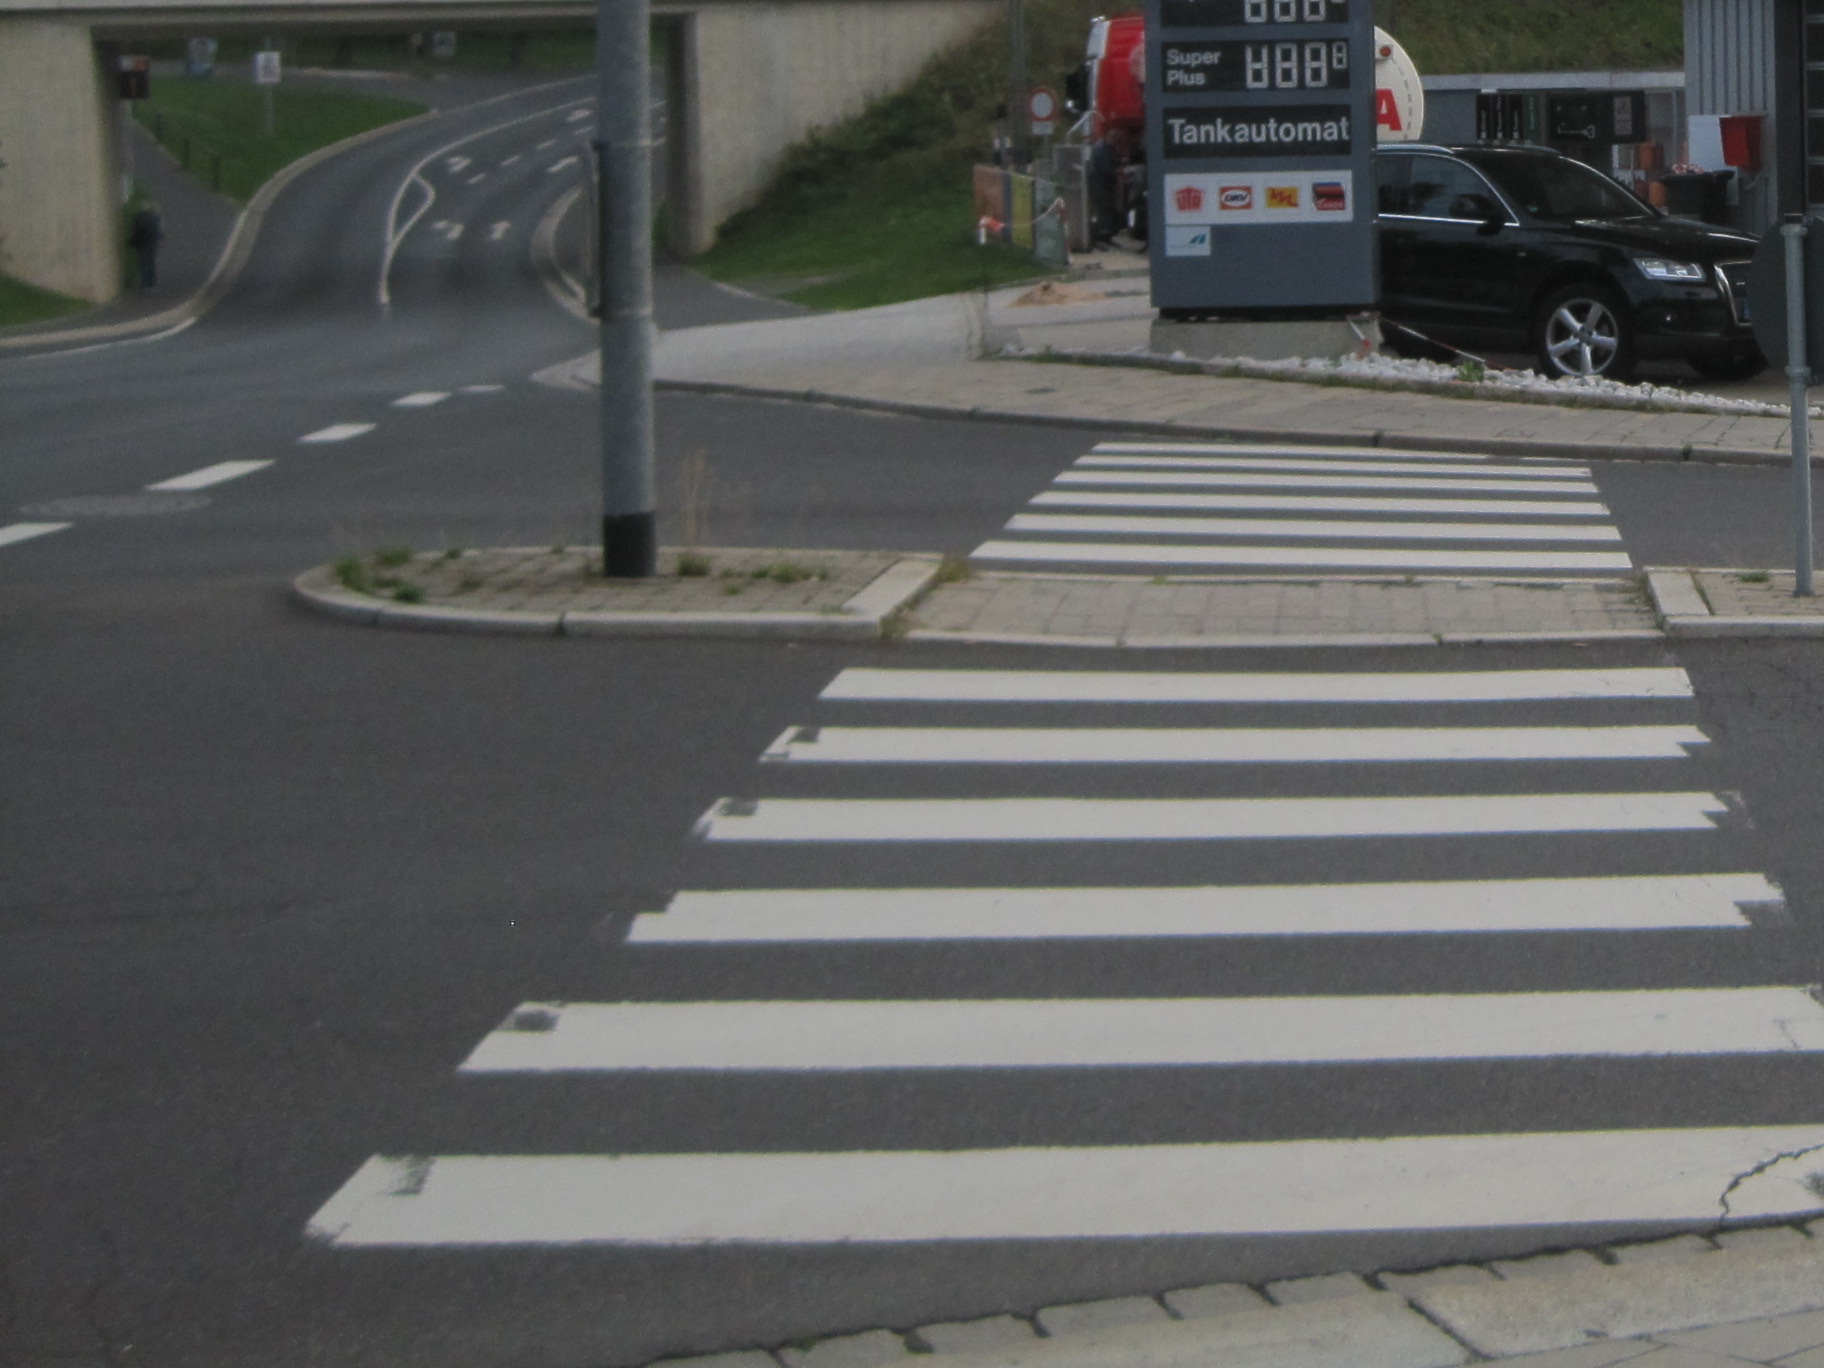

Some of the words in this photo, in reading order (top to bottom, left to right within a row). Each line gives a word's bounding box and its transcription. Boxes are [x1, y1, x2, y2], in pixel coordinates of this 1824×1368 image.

[1166, 48, 1221, 68] Super
[1166, 69, 1206, 86] Plus
[1167, 116, 1349, 145] Tankautomat
